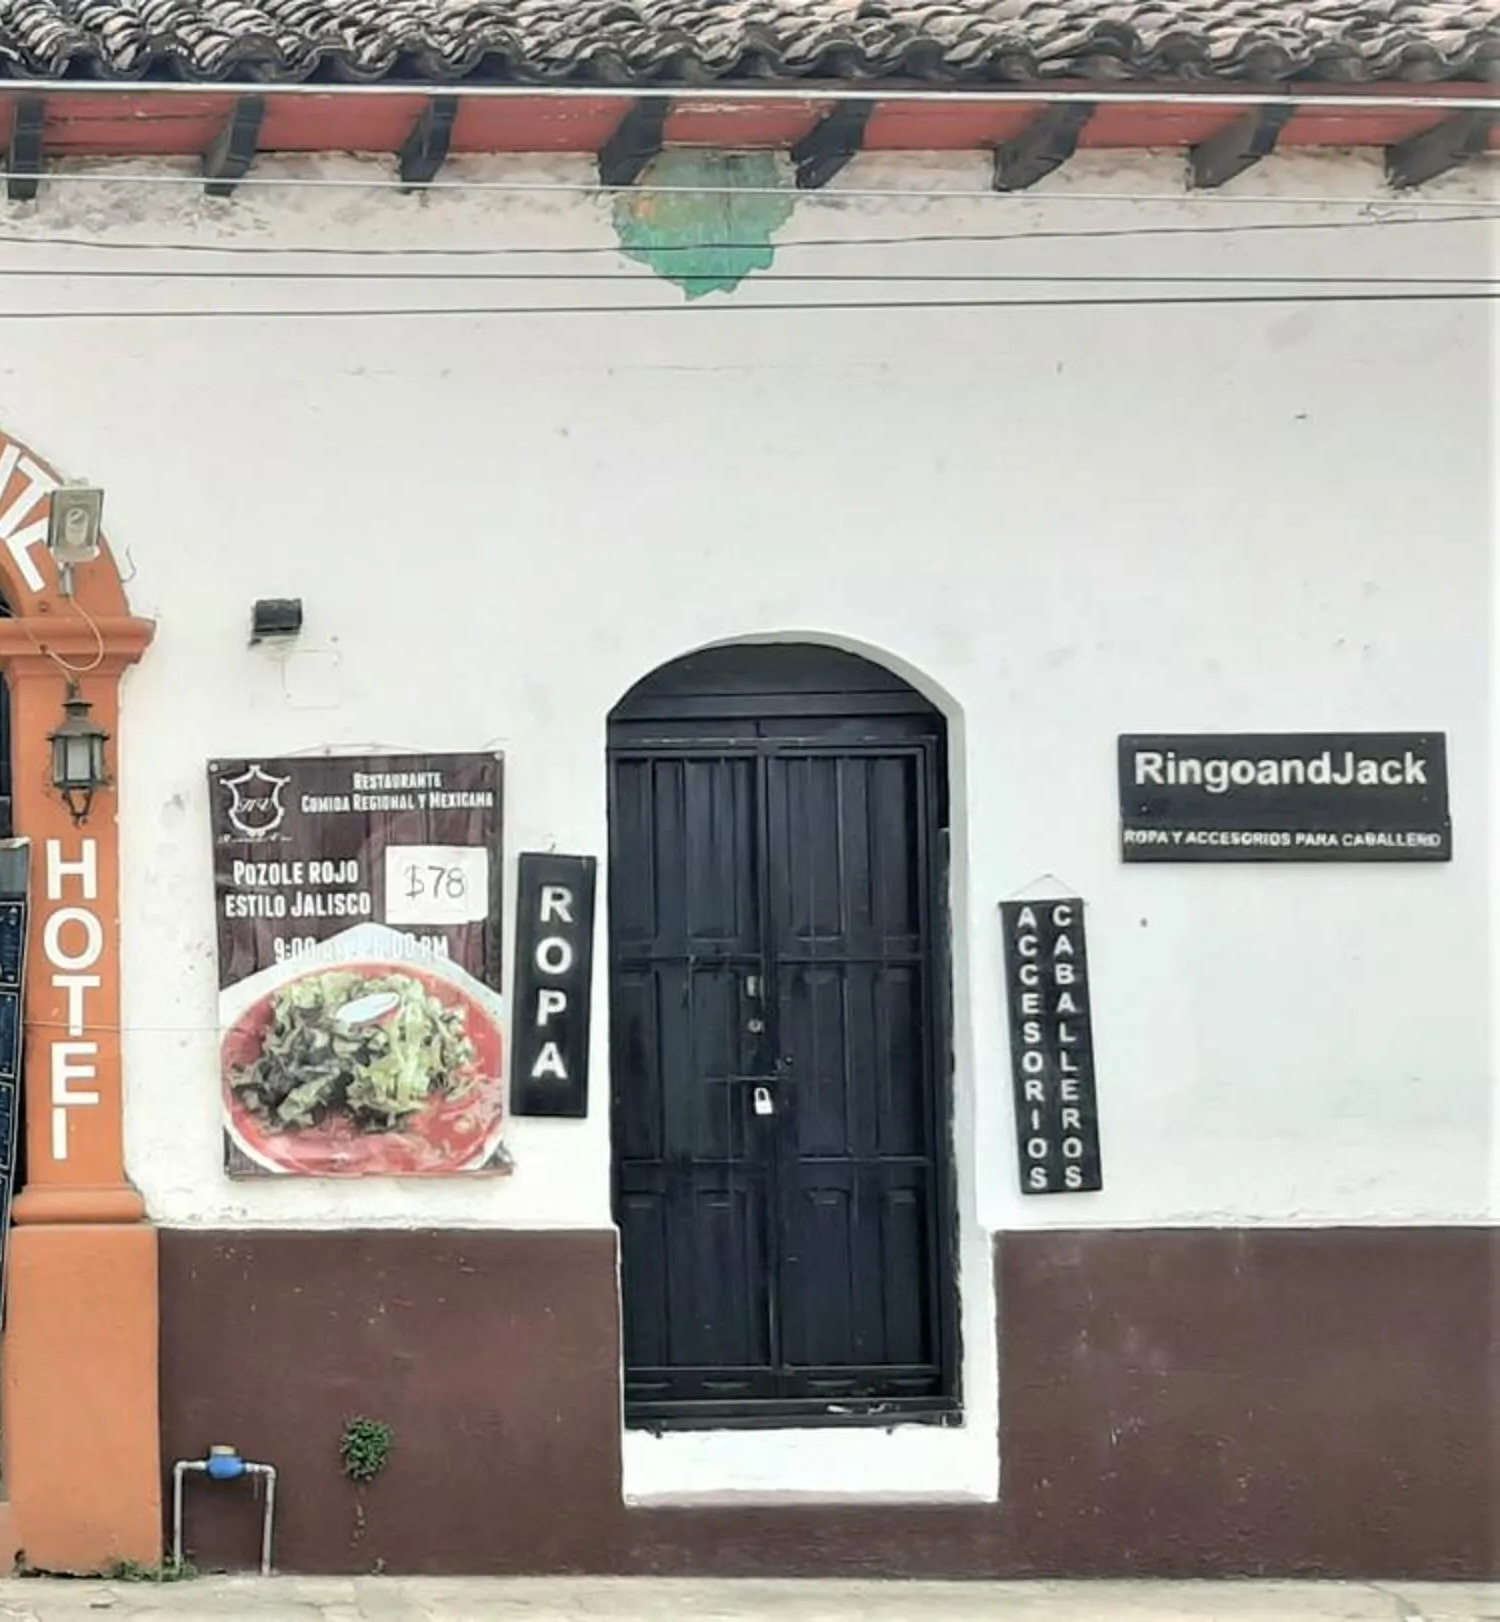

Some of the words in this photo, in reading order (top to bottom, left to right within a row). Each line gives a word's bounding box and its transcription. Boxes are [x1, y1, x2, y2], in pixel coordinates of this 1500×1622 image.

[352, 771, 443, 790] RESTAURANTE
[1134, 750, 1427, 794] RingoandJack
[301, 794, 350, 814] COMIDA
[353, 793, 414, 812] REGIONAL
[428, 791, 494, 811] MEXICANA
[1123, 830, 1169, 845] ROPA
[1172, 831, 1183, 845] Y
[1185, 830, 1291, 846] ACCESORIOS
[1295, 832, 1338, 847] PARA
[233, 859, 304, 886] POZOLE
[308, 859, 359, 885] ROJO
[404, 863, 466, 900] $78
[225, 893, 286, 918] ESTILO
[290, 891, 371, 918] JALISCO
[531, 885, 575, 1081] ROPA
[1016, 906, 1049, 1189] ACCESORIOS
[1052, 905, 1084, 1188] CABALLEROS
